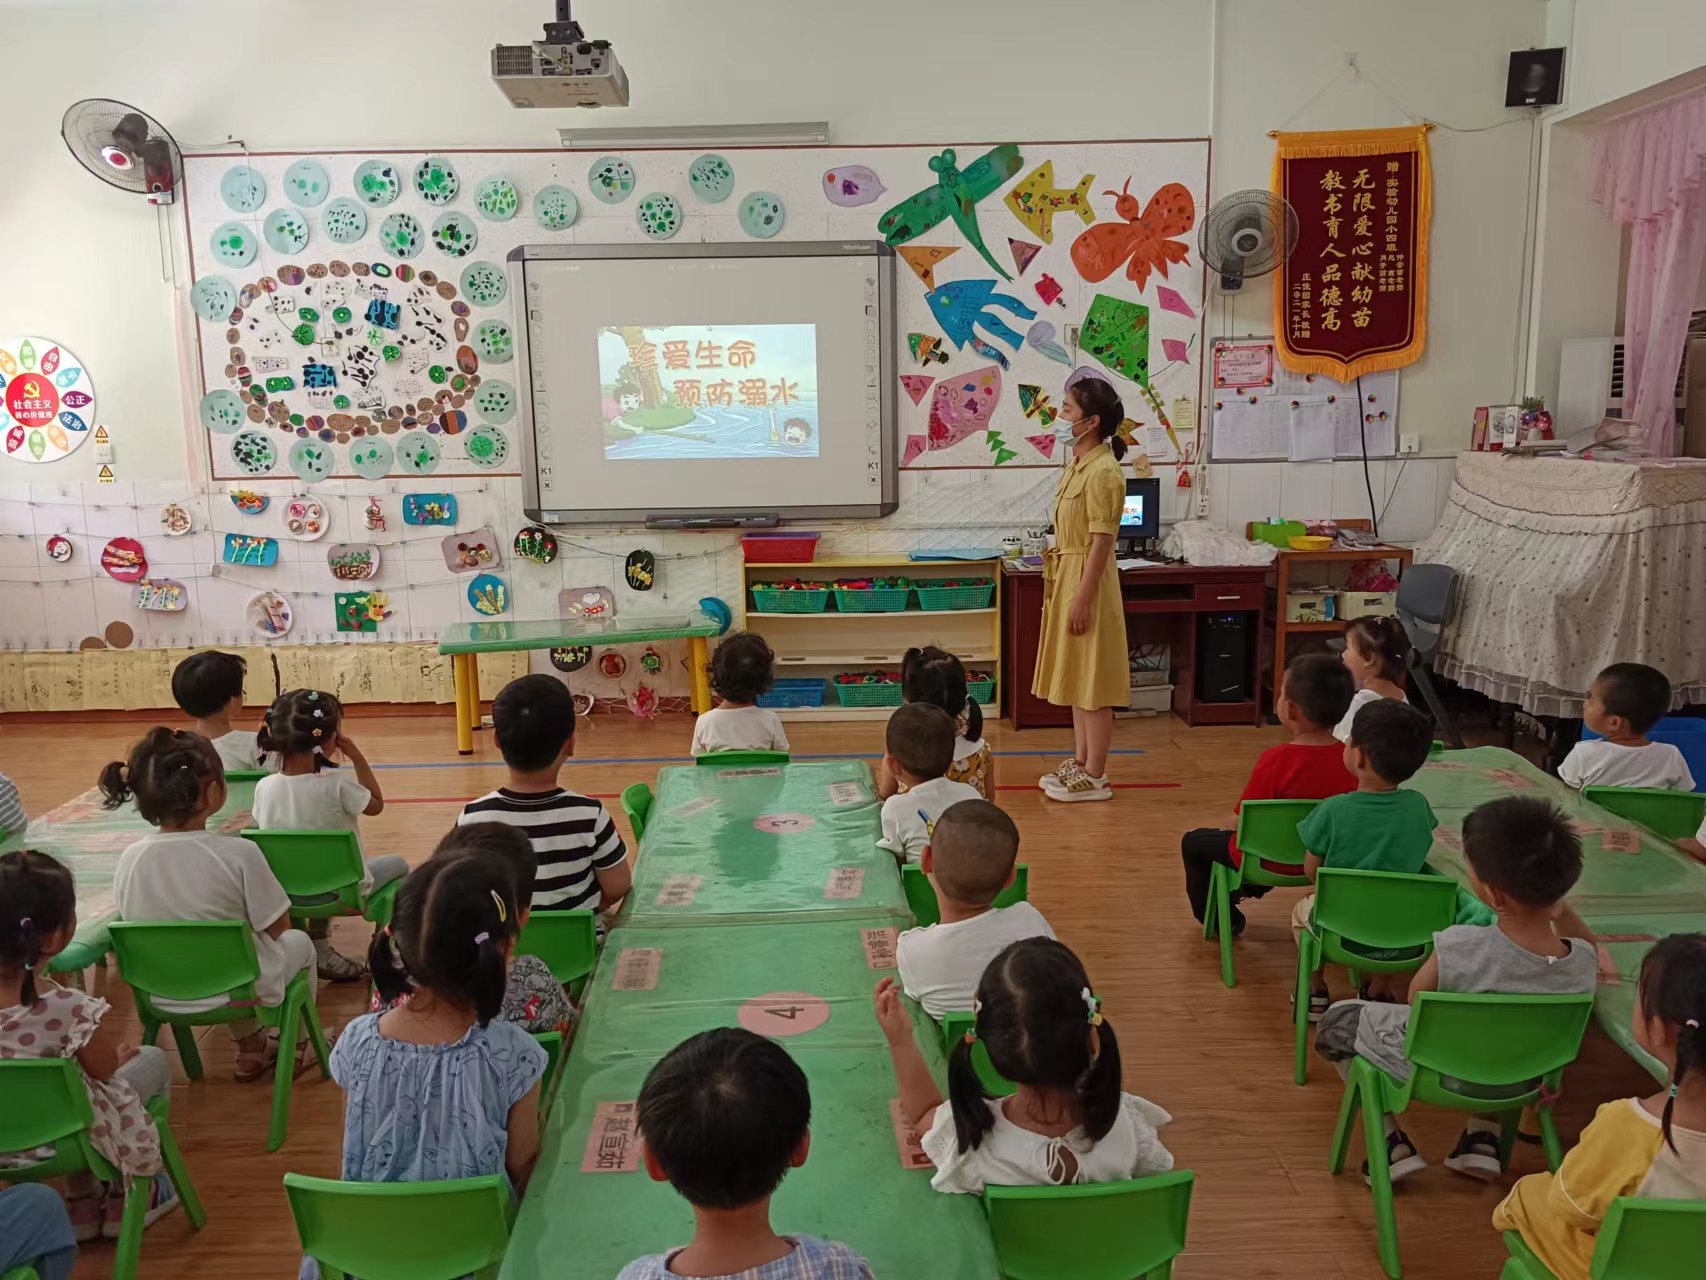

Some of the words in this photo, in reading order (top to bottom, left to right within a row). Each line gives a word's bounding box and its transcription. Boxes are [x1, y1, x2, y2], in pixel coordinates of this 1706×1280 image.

[1319, 169, 1347, 331] 教书育人品德高
[1351, 168, 1376, 328] 无限爱心献幼苗
[43, 352, 58, 372] 自由
[629, 340, 756, 370] 珍爱生命
[65, 395, 86, 405] 公正
[672, 377, 800, 408] 预防溺水
[13, 399, 52, 410] 社会主义
[62, 413, 82, 430] 法治
[541, 467, 552, 475] K1
[868, 462, 879, 470] K1
[771, 819, 799, 827] 3
[764, 1006, 805, 1020] 4
